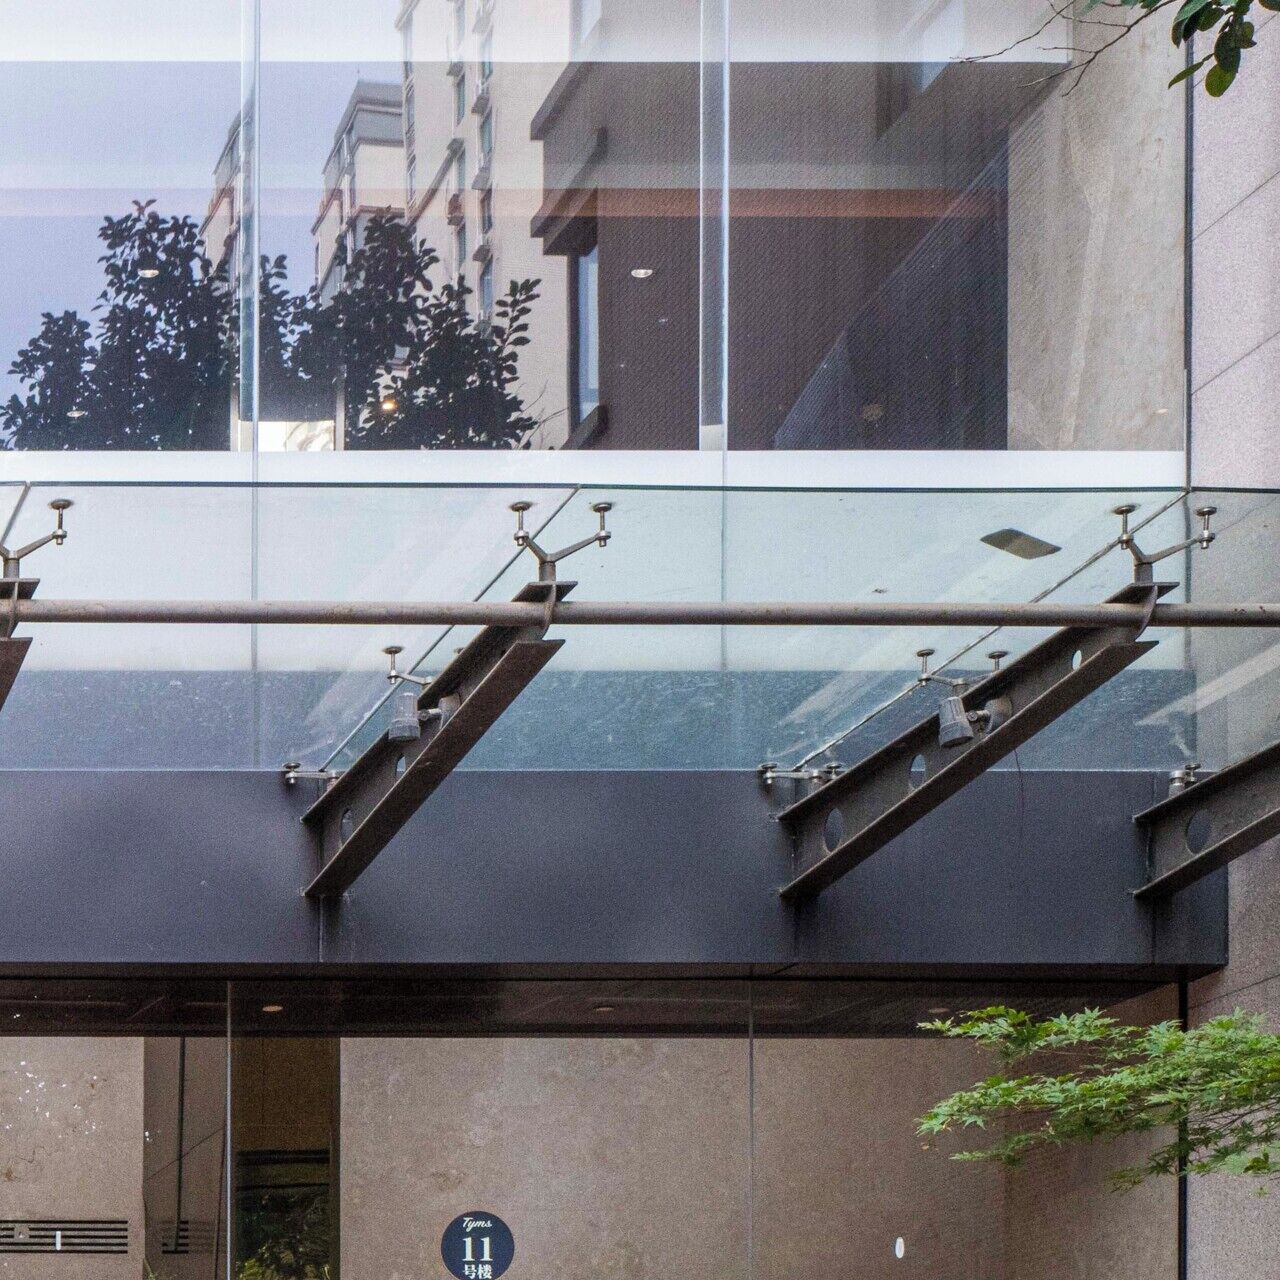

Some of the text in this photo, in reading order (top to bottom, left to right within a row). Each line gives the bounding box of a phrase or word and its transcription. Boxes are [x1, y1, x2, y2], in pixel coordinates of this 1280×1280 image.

[462, 1217, 493, 1232] Tyms
[462, 1236, 493, 1261] 11
[462, 1263, 492, 1279] 号楼
